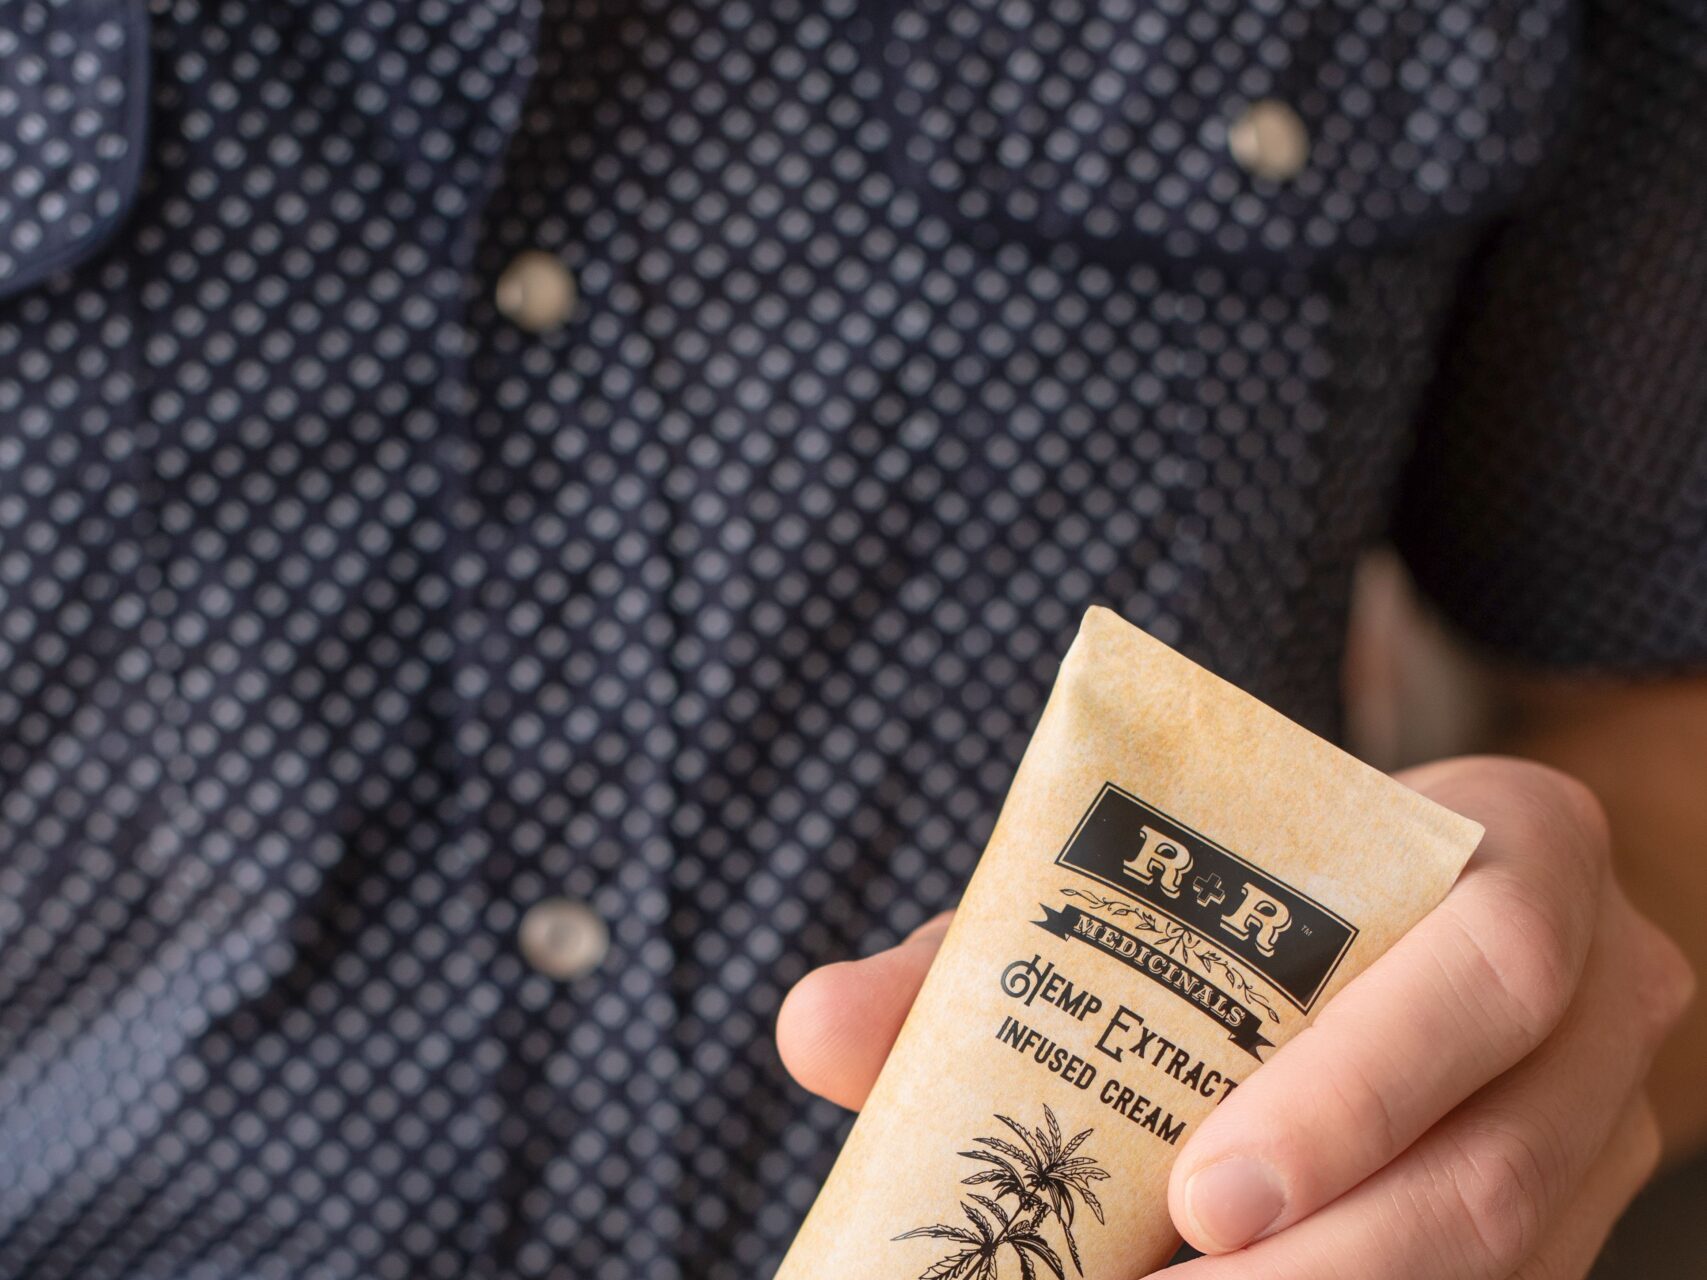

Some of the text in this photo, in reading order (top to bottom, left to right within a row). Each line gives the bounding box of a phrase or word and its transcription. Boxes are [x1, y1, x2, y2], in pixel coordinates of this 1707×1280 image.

[1073, 914, 1246, 1027] MEDICINALS
[995, 1016, 1187, 1146] INFUSED CREAM
